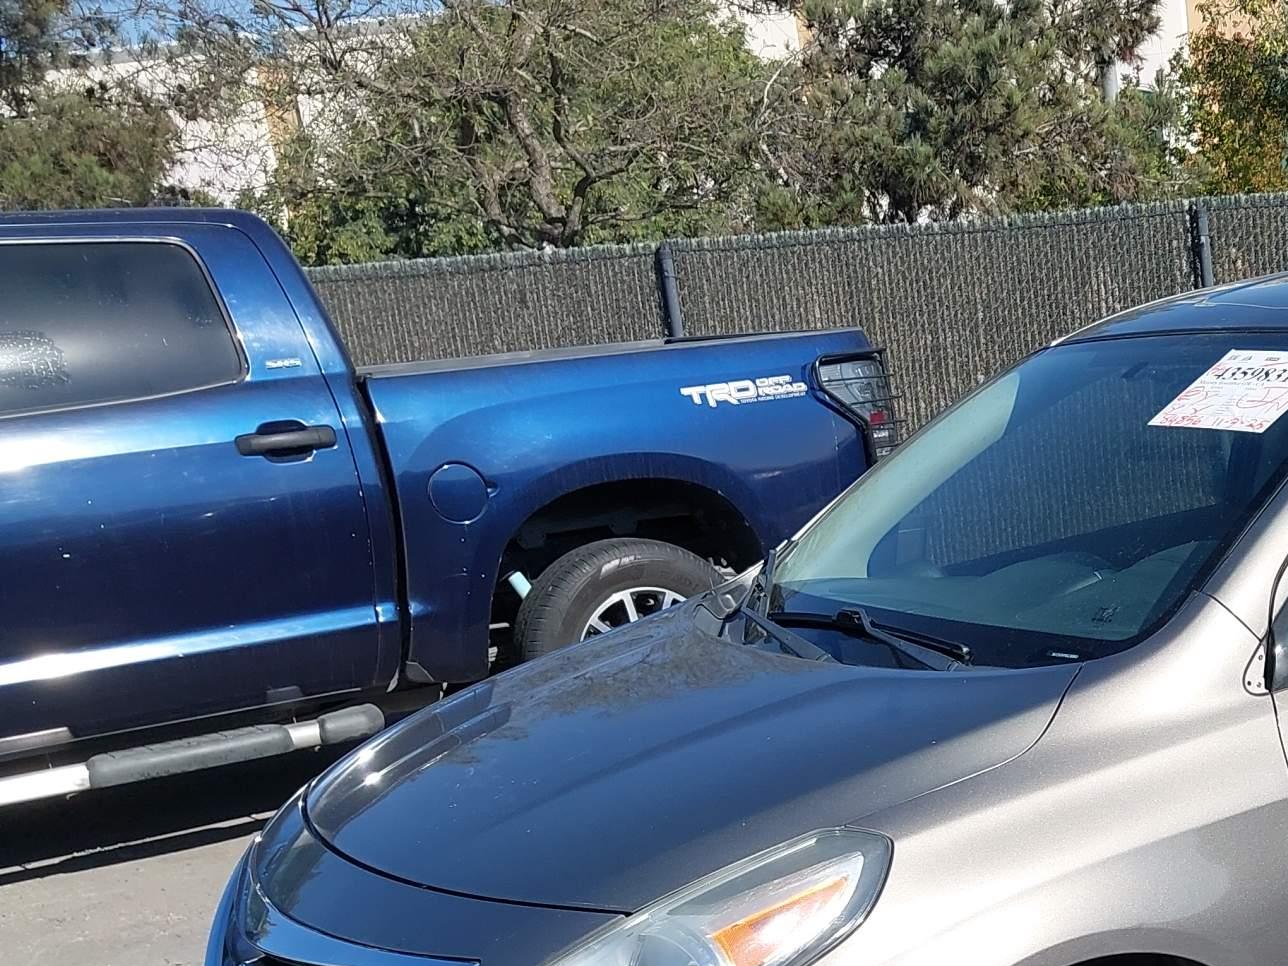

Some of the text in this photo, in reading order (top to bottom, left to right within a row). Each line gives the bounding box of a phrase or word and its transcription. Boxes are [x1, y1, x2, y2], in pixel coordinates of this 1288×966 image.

[755, 375, 792, 387] OFF
[680, 379, 757, 408] TRD
[758, 382, 807, 396] ROAD
